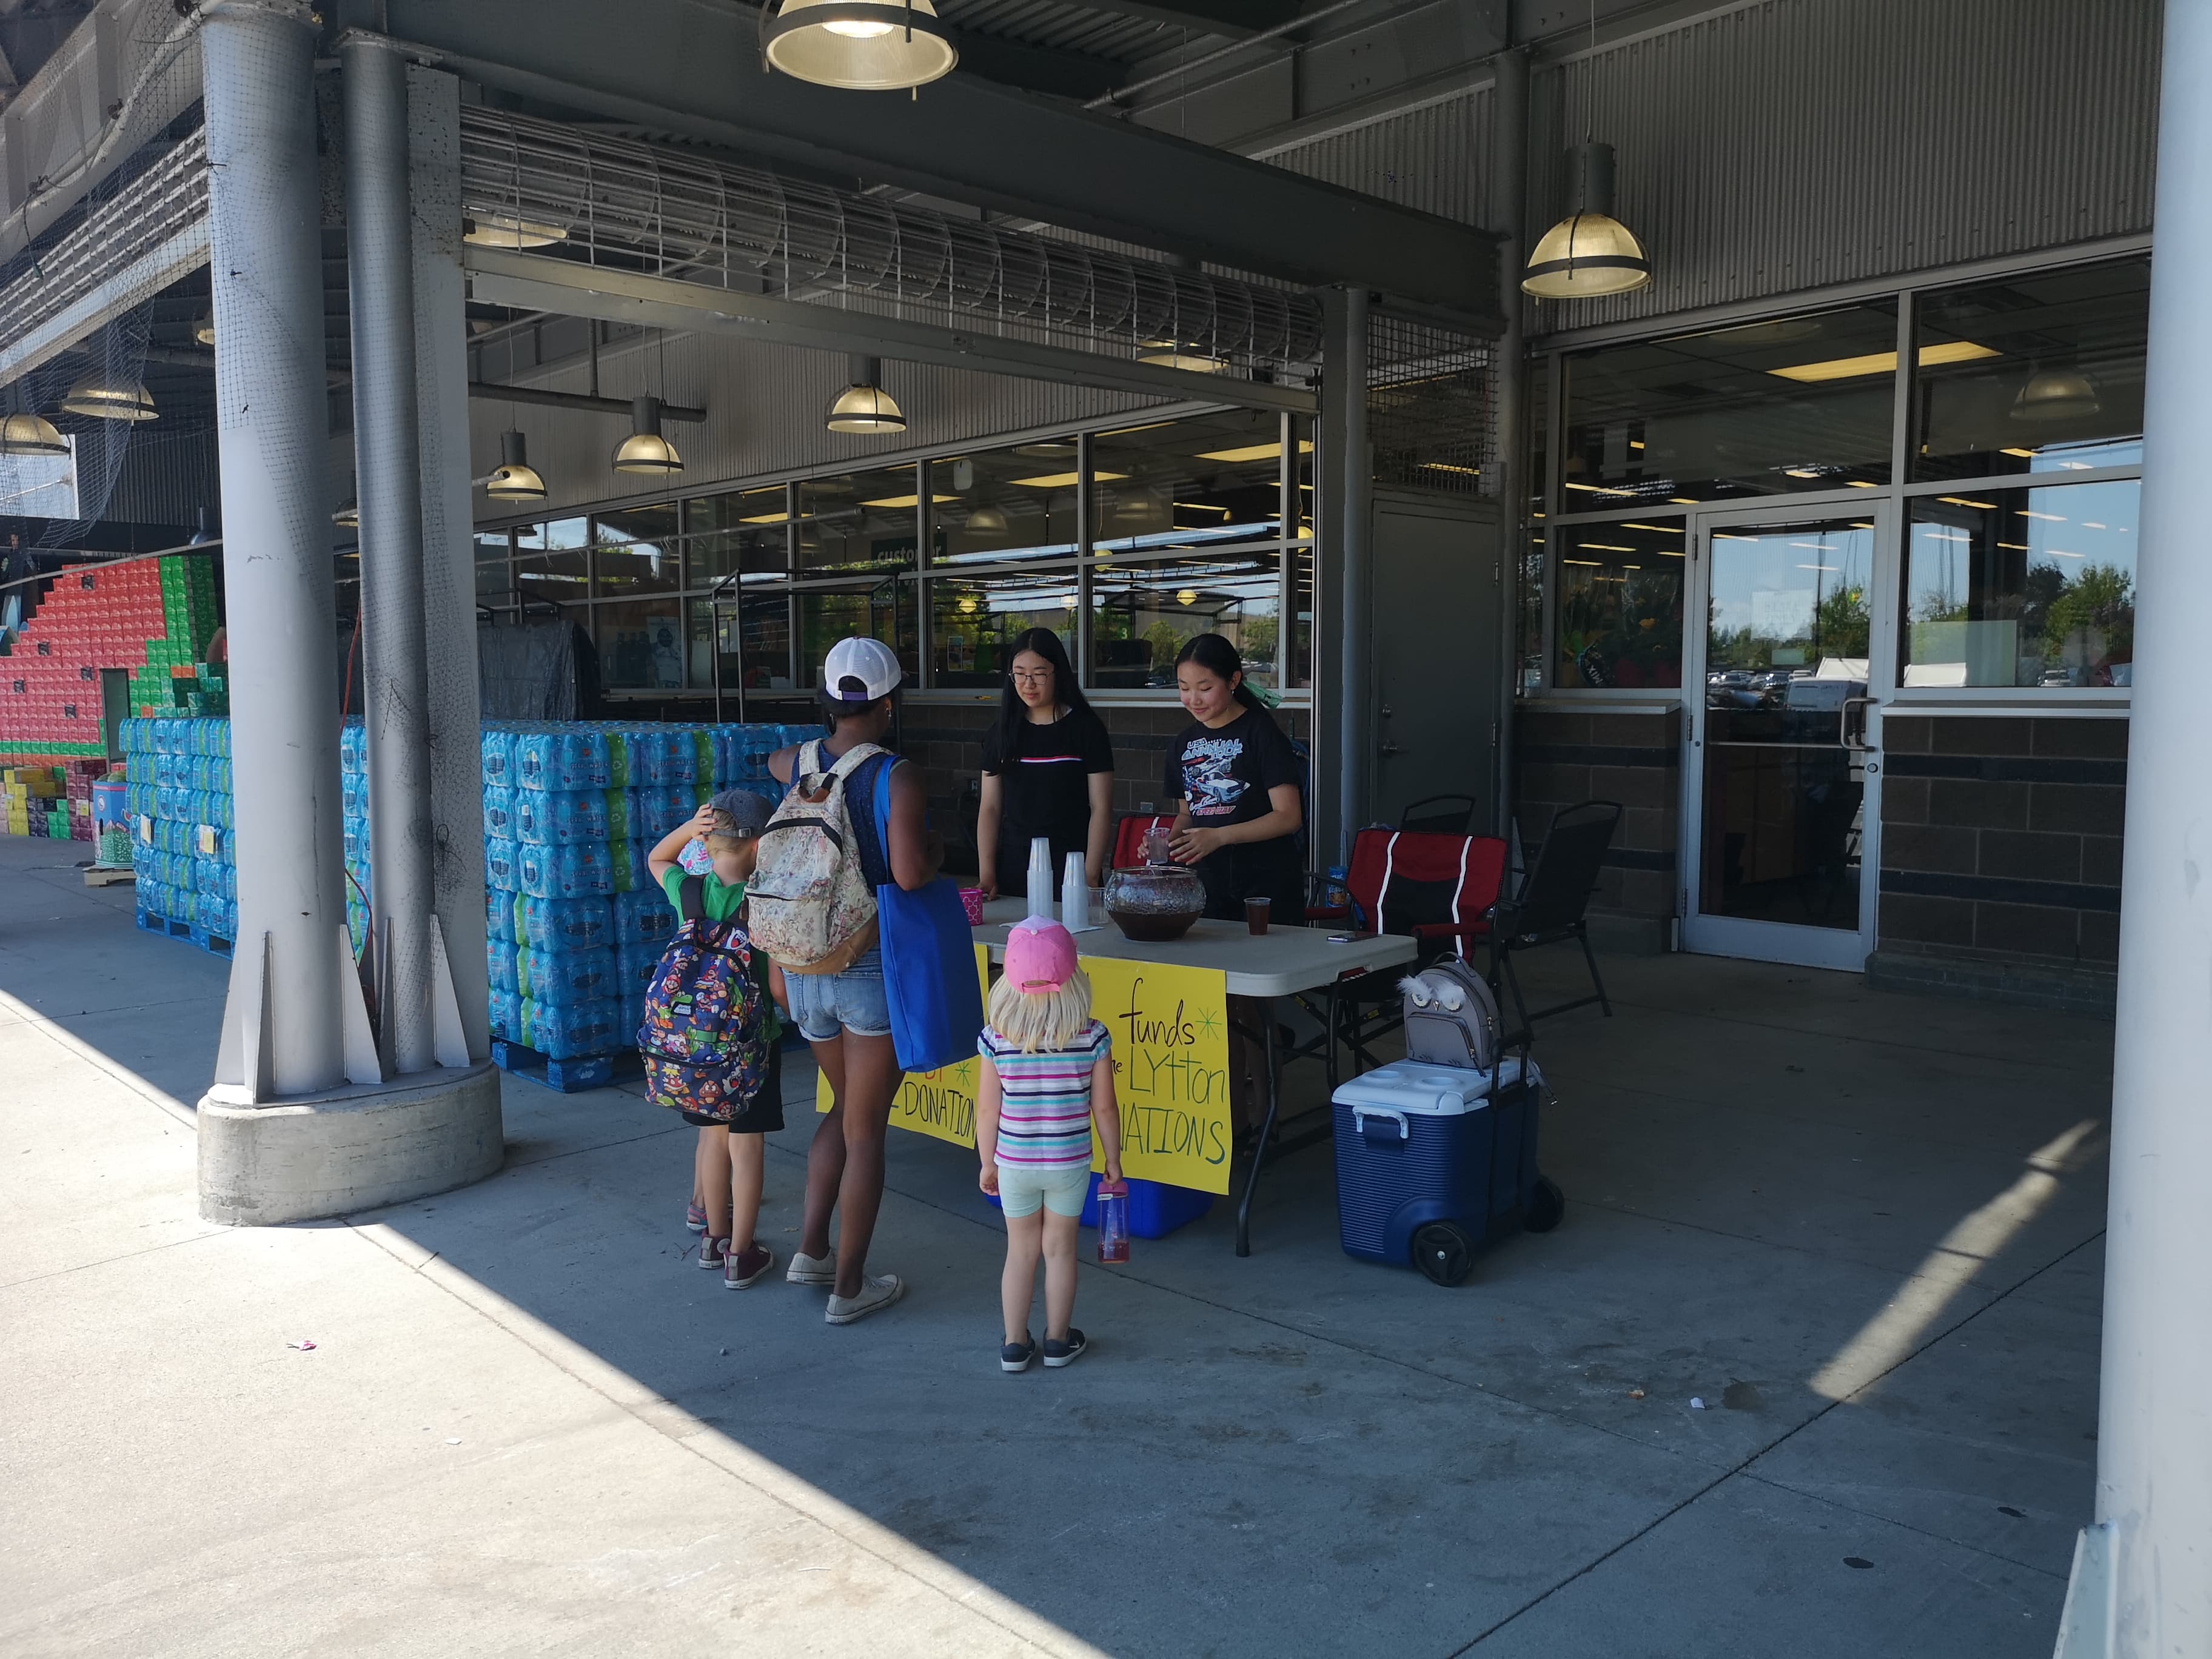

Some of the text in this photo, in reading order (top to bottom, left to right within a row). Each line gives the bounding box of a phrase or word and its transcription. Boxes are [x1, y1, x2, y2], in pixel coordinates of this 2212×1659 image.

[1121, 627, 1128, 640] 3
[1187, 737, 1207, 749] USA
[1119, 977, 1195, 1047] funds
[905, 1082, 977, 1141] DONATION
